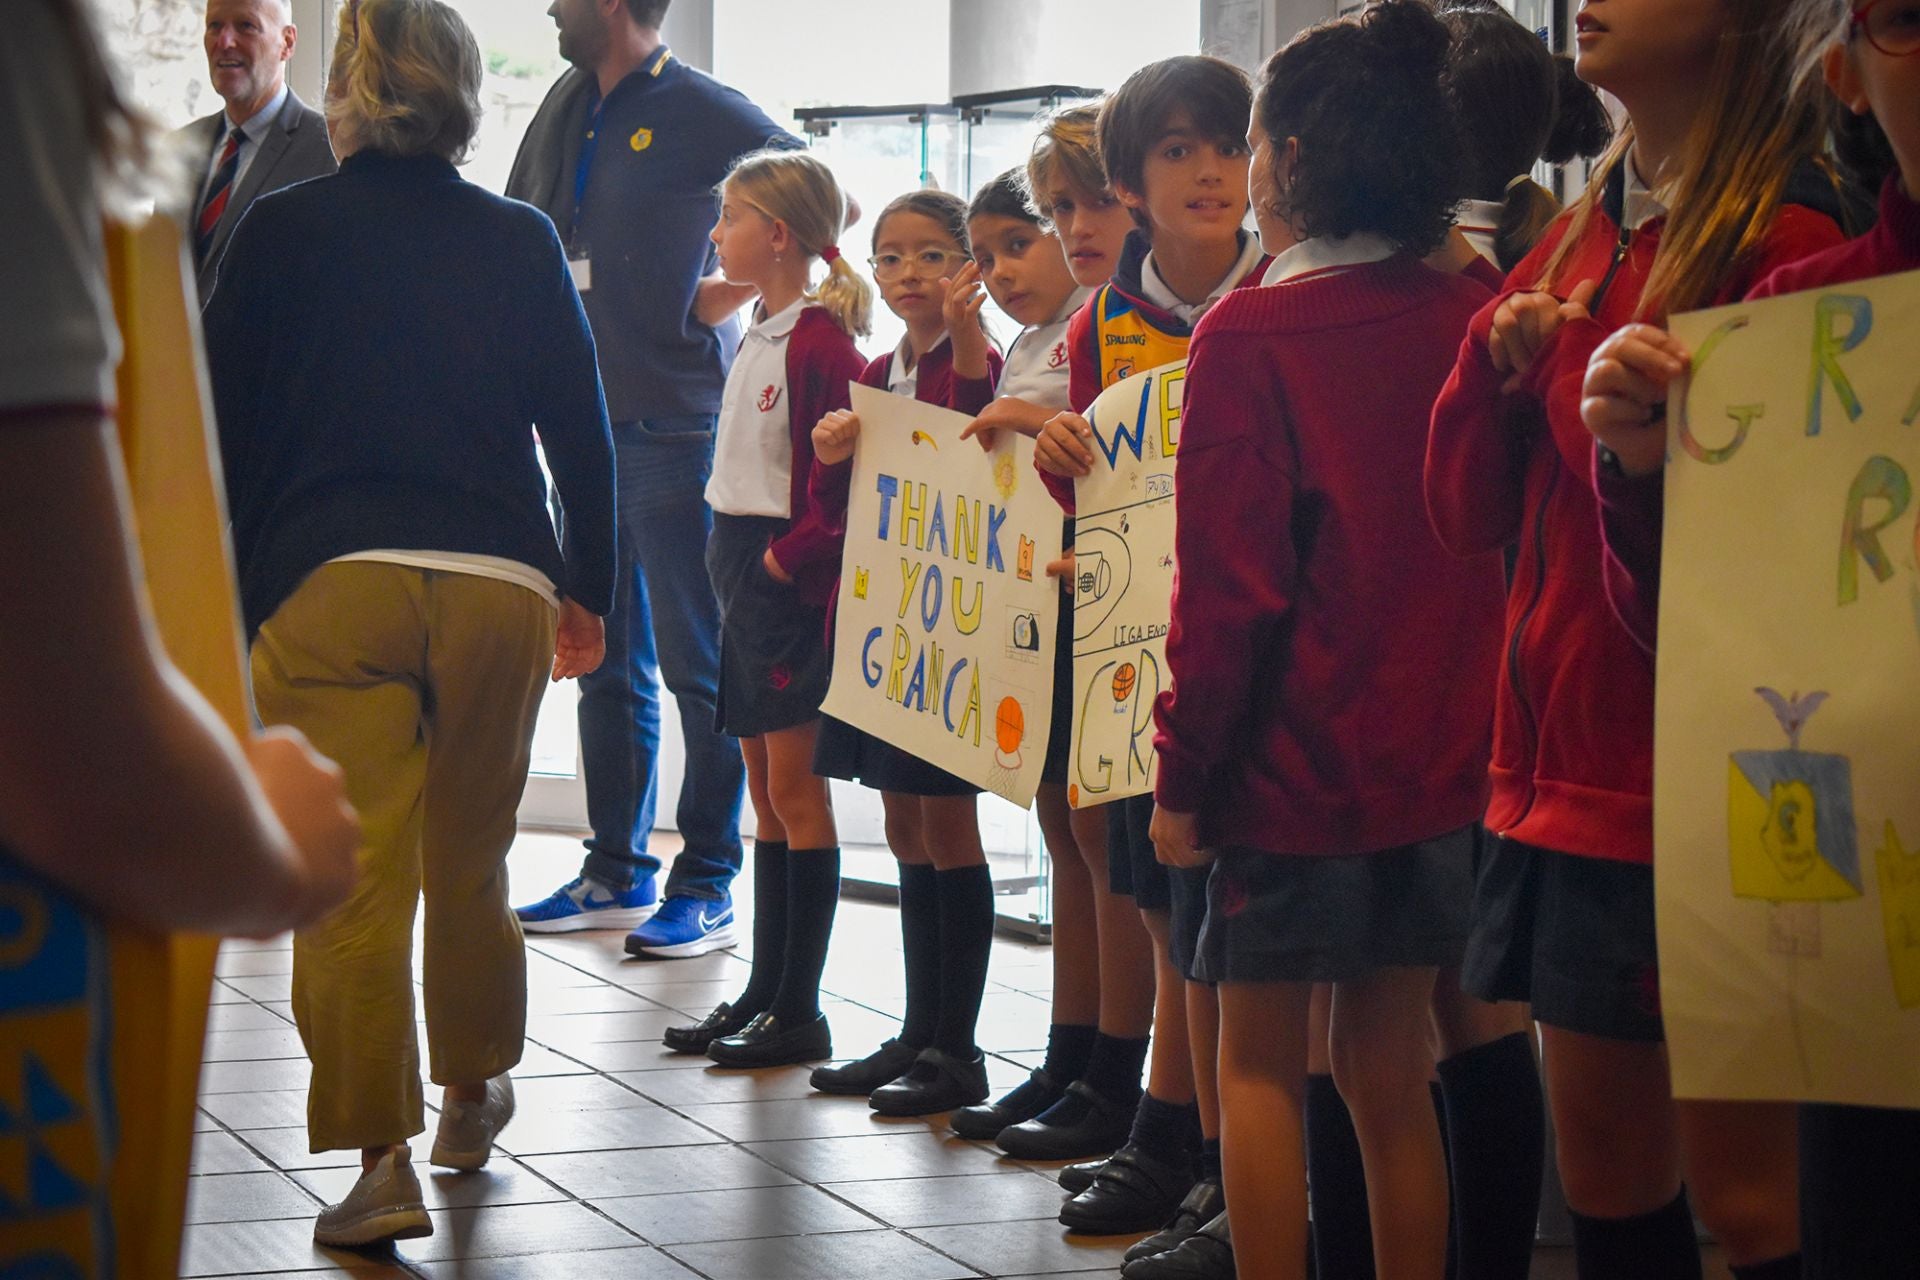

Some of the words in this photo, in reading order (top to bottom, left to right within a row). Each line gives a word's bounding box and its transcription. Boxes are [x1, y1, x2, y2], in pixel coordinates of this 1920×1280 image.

[1105, 334, 1146, 347] SPALDING
[876, 473, 1006, 573] THANK
[1838, 456, 1920, 606] R
[898, 557, 983, 635] YOU
[1114, 625, 1142, 647] LIGA
[861, 624, 981, 748] GRANCA
[1077, 648, 1160, 793] GR
